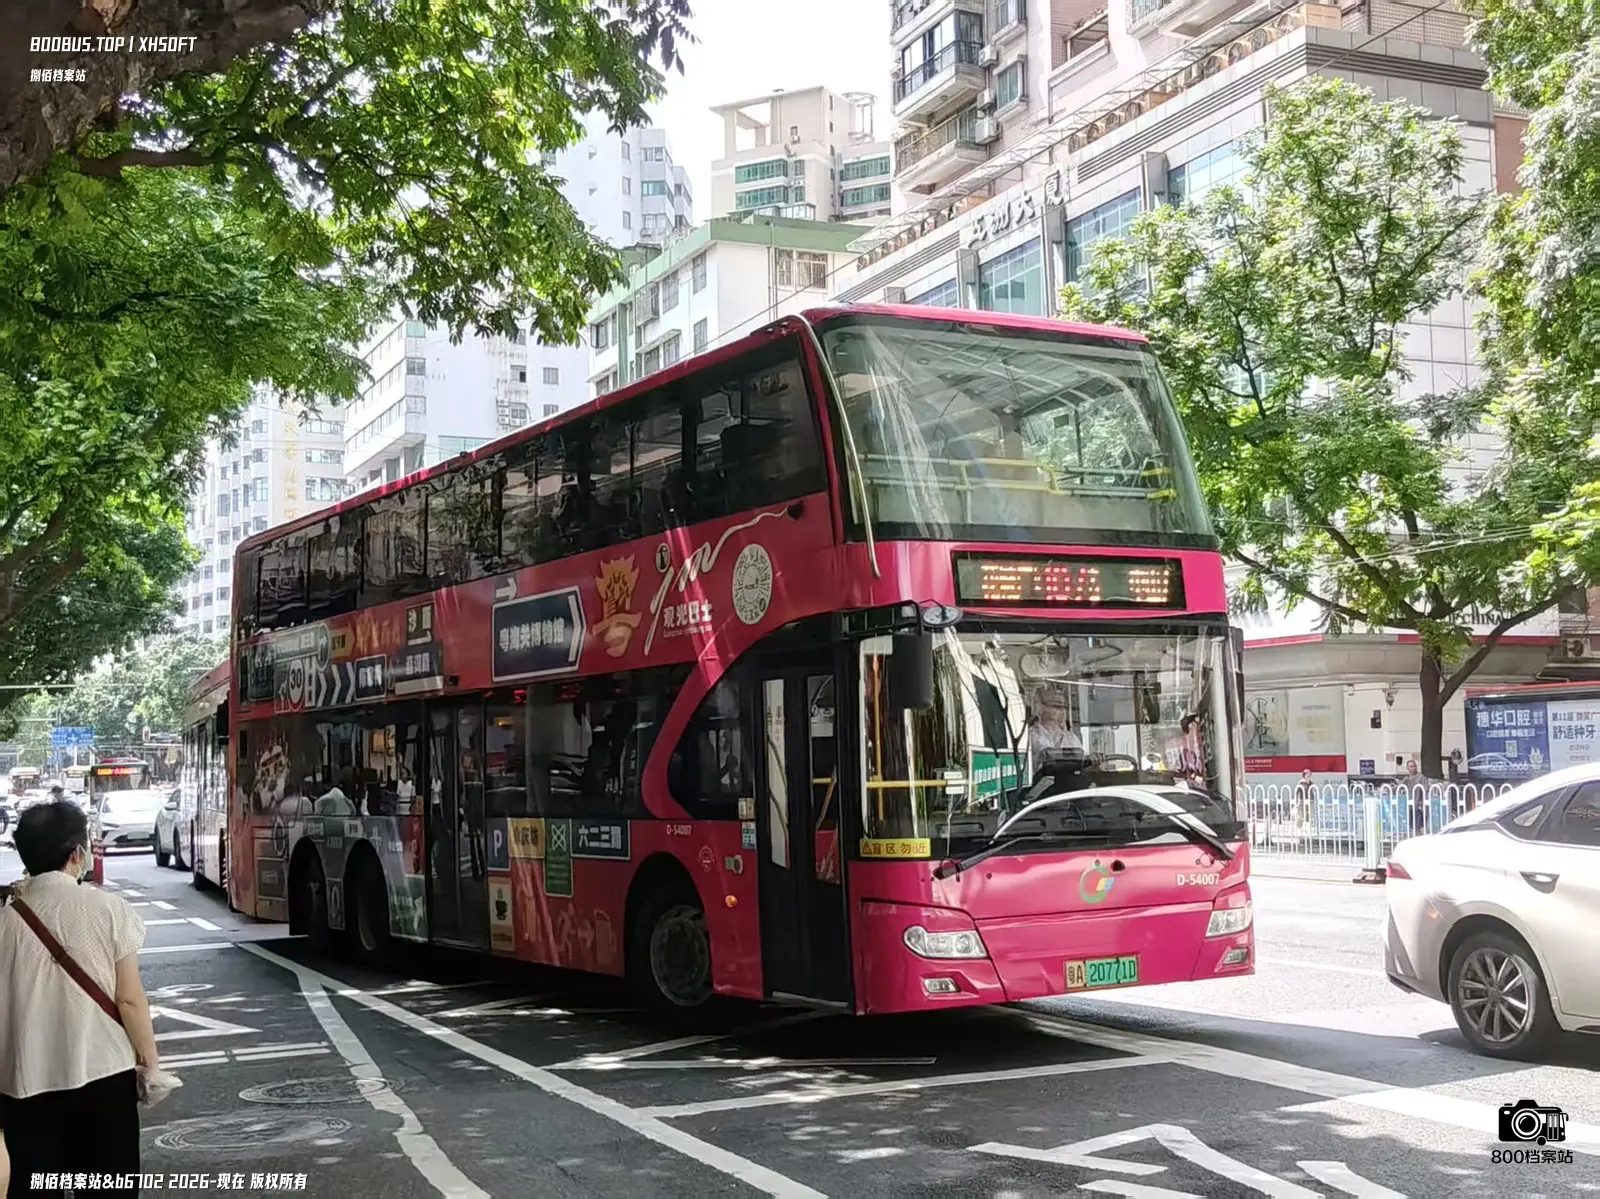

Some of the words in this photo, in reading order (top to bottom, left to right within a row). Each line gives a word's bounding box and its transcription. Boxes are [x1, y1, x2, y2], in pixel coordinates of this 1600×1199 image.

[663, 600, 712, 628] 观光巴士
[499, 616, 565, 653] 粤海关博物馆
[290, 668, 303, 690] 30
[1476, 709, 1531, 728] 穗华口腔
[1552, 724, 1596, 740] 舒适种牙
[578, 825, 622, 850] 六二三路
[666, 824, 692, 836] D-54007
[493, 829, 503, 858] P
[872, 843, 927, 855] 盲区勿近
[1177, 873, 1220, 886] D-54007
